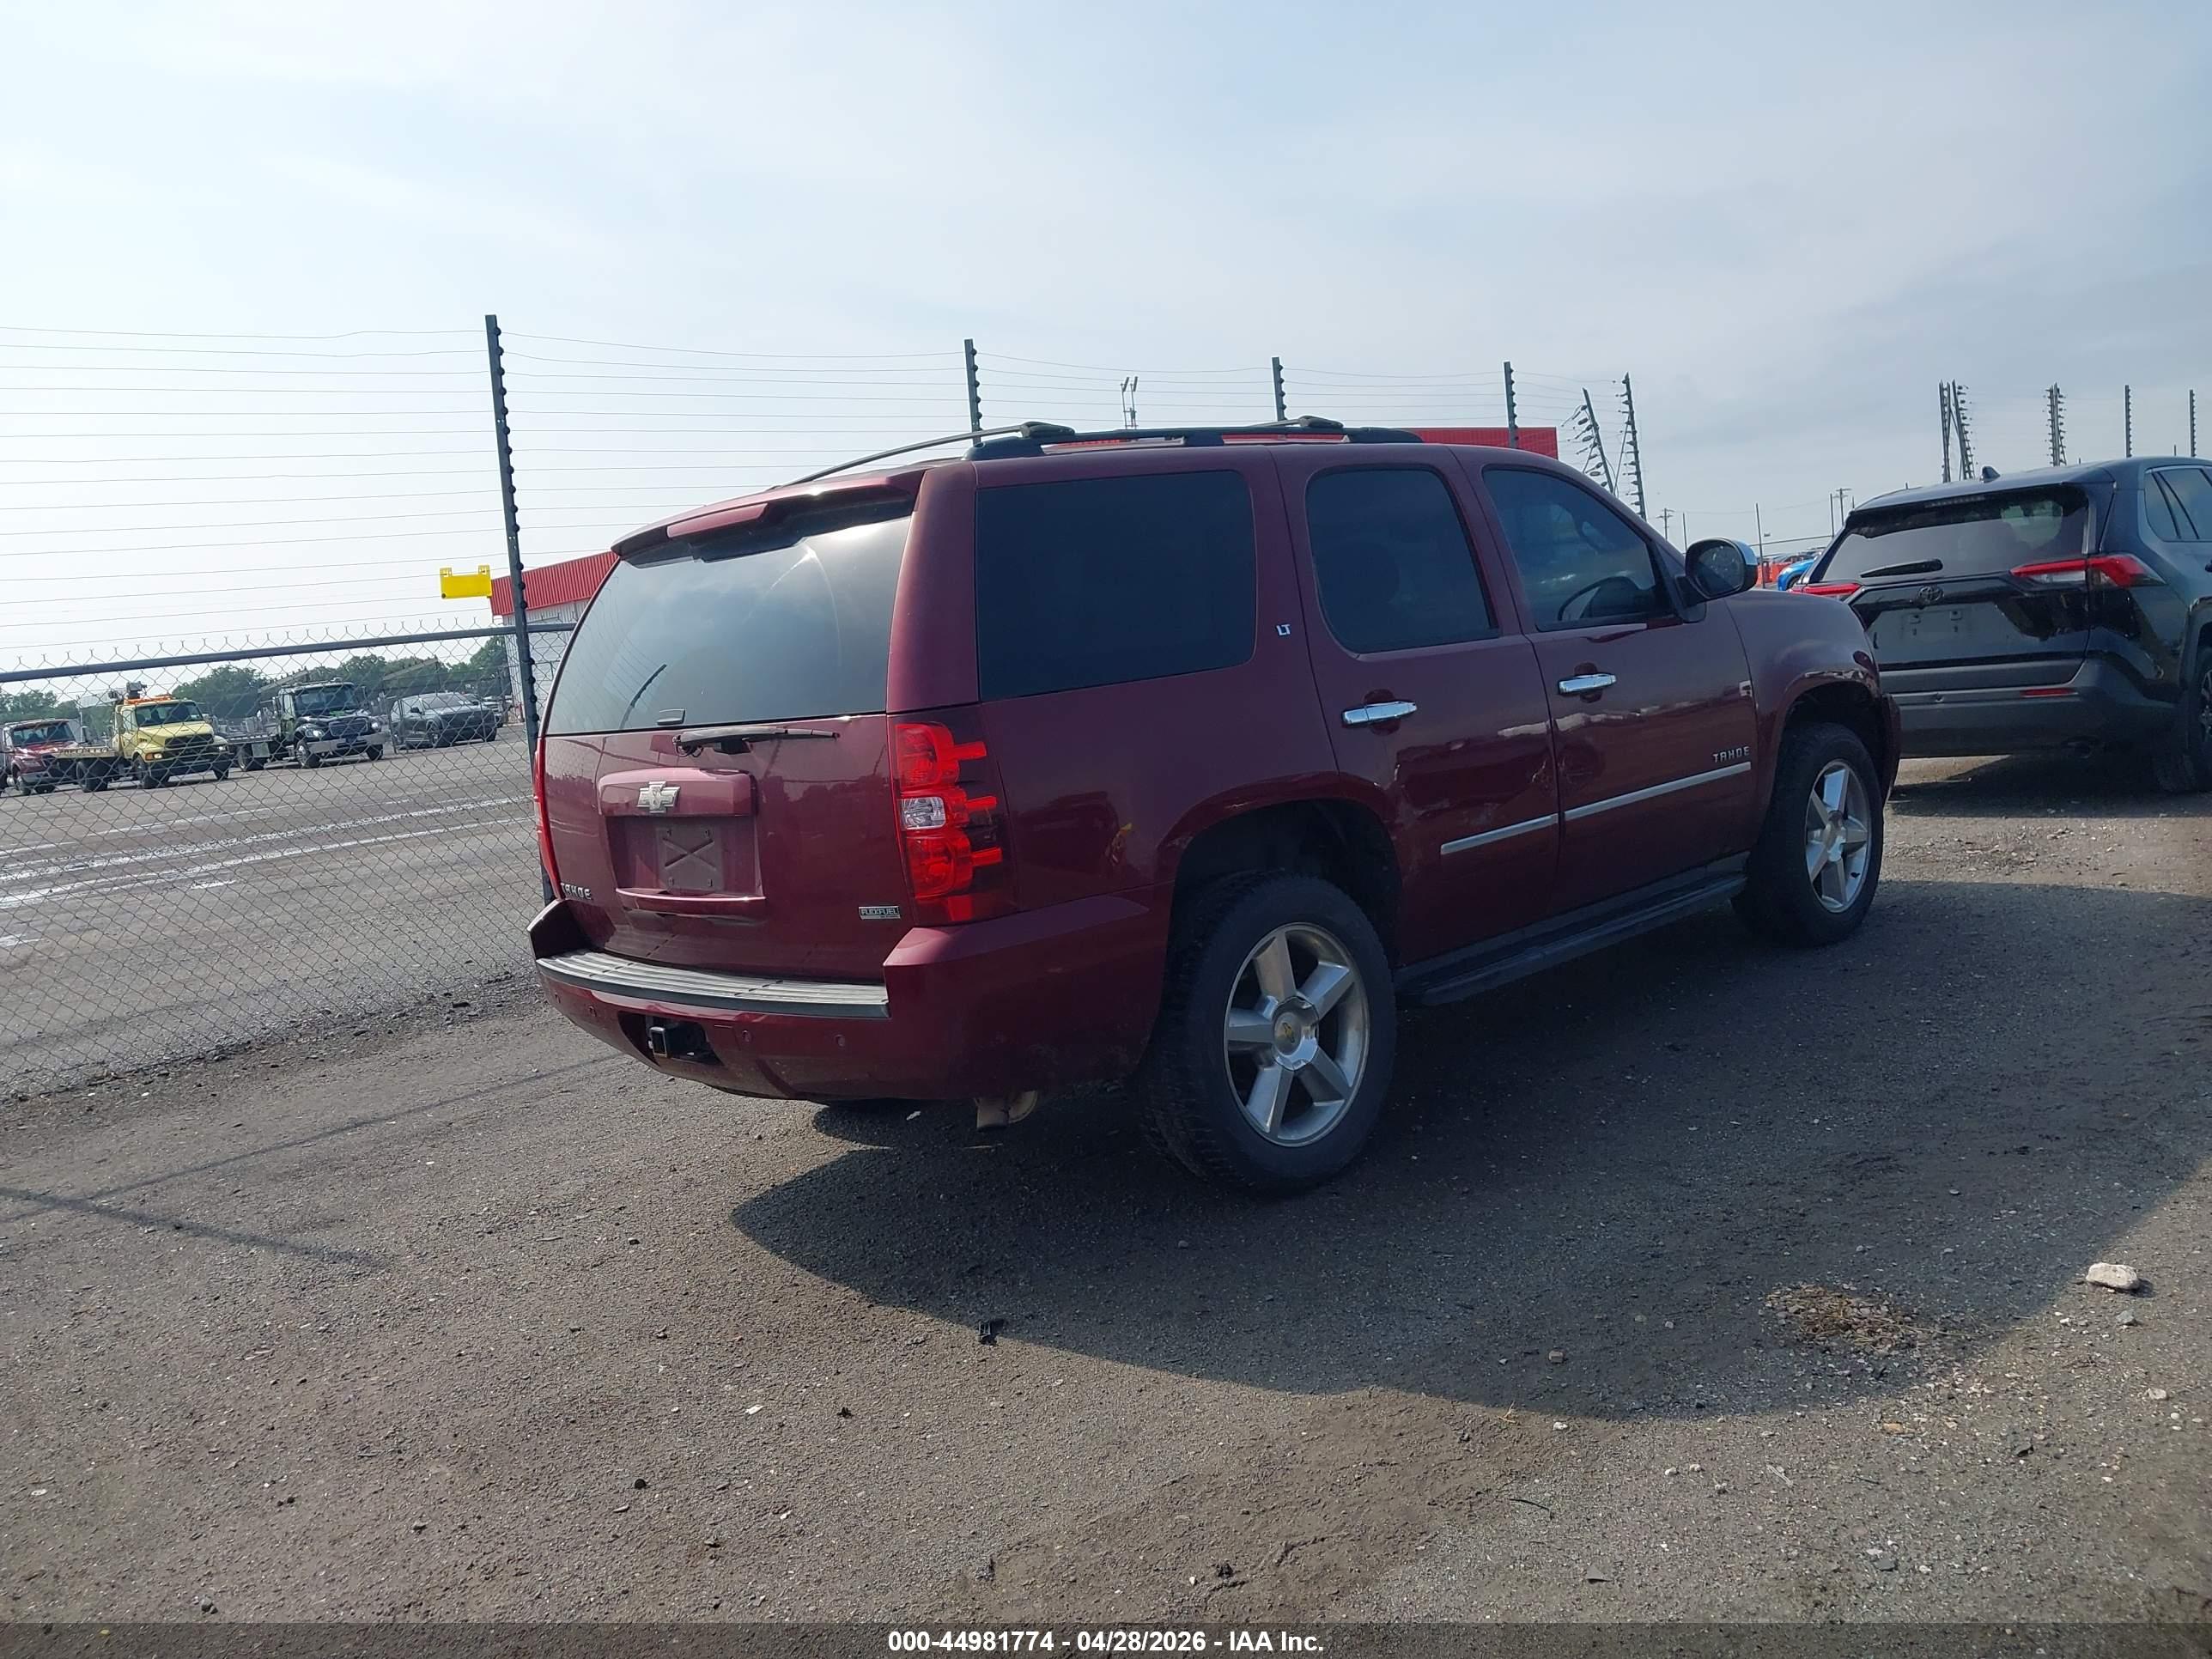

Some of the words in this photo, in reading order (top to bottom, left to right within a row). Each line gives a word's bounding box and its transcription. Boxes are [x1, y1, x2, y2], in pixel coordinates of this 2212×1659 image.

[1276, 624, 1291, 635] LT
[1713, 746, 1750, 763] TAHOE
[560, 883, 592, 900] TAHOE
